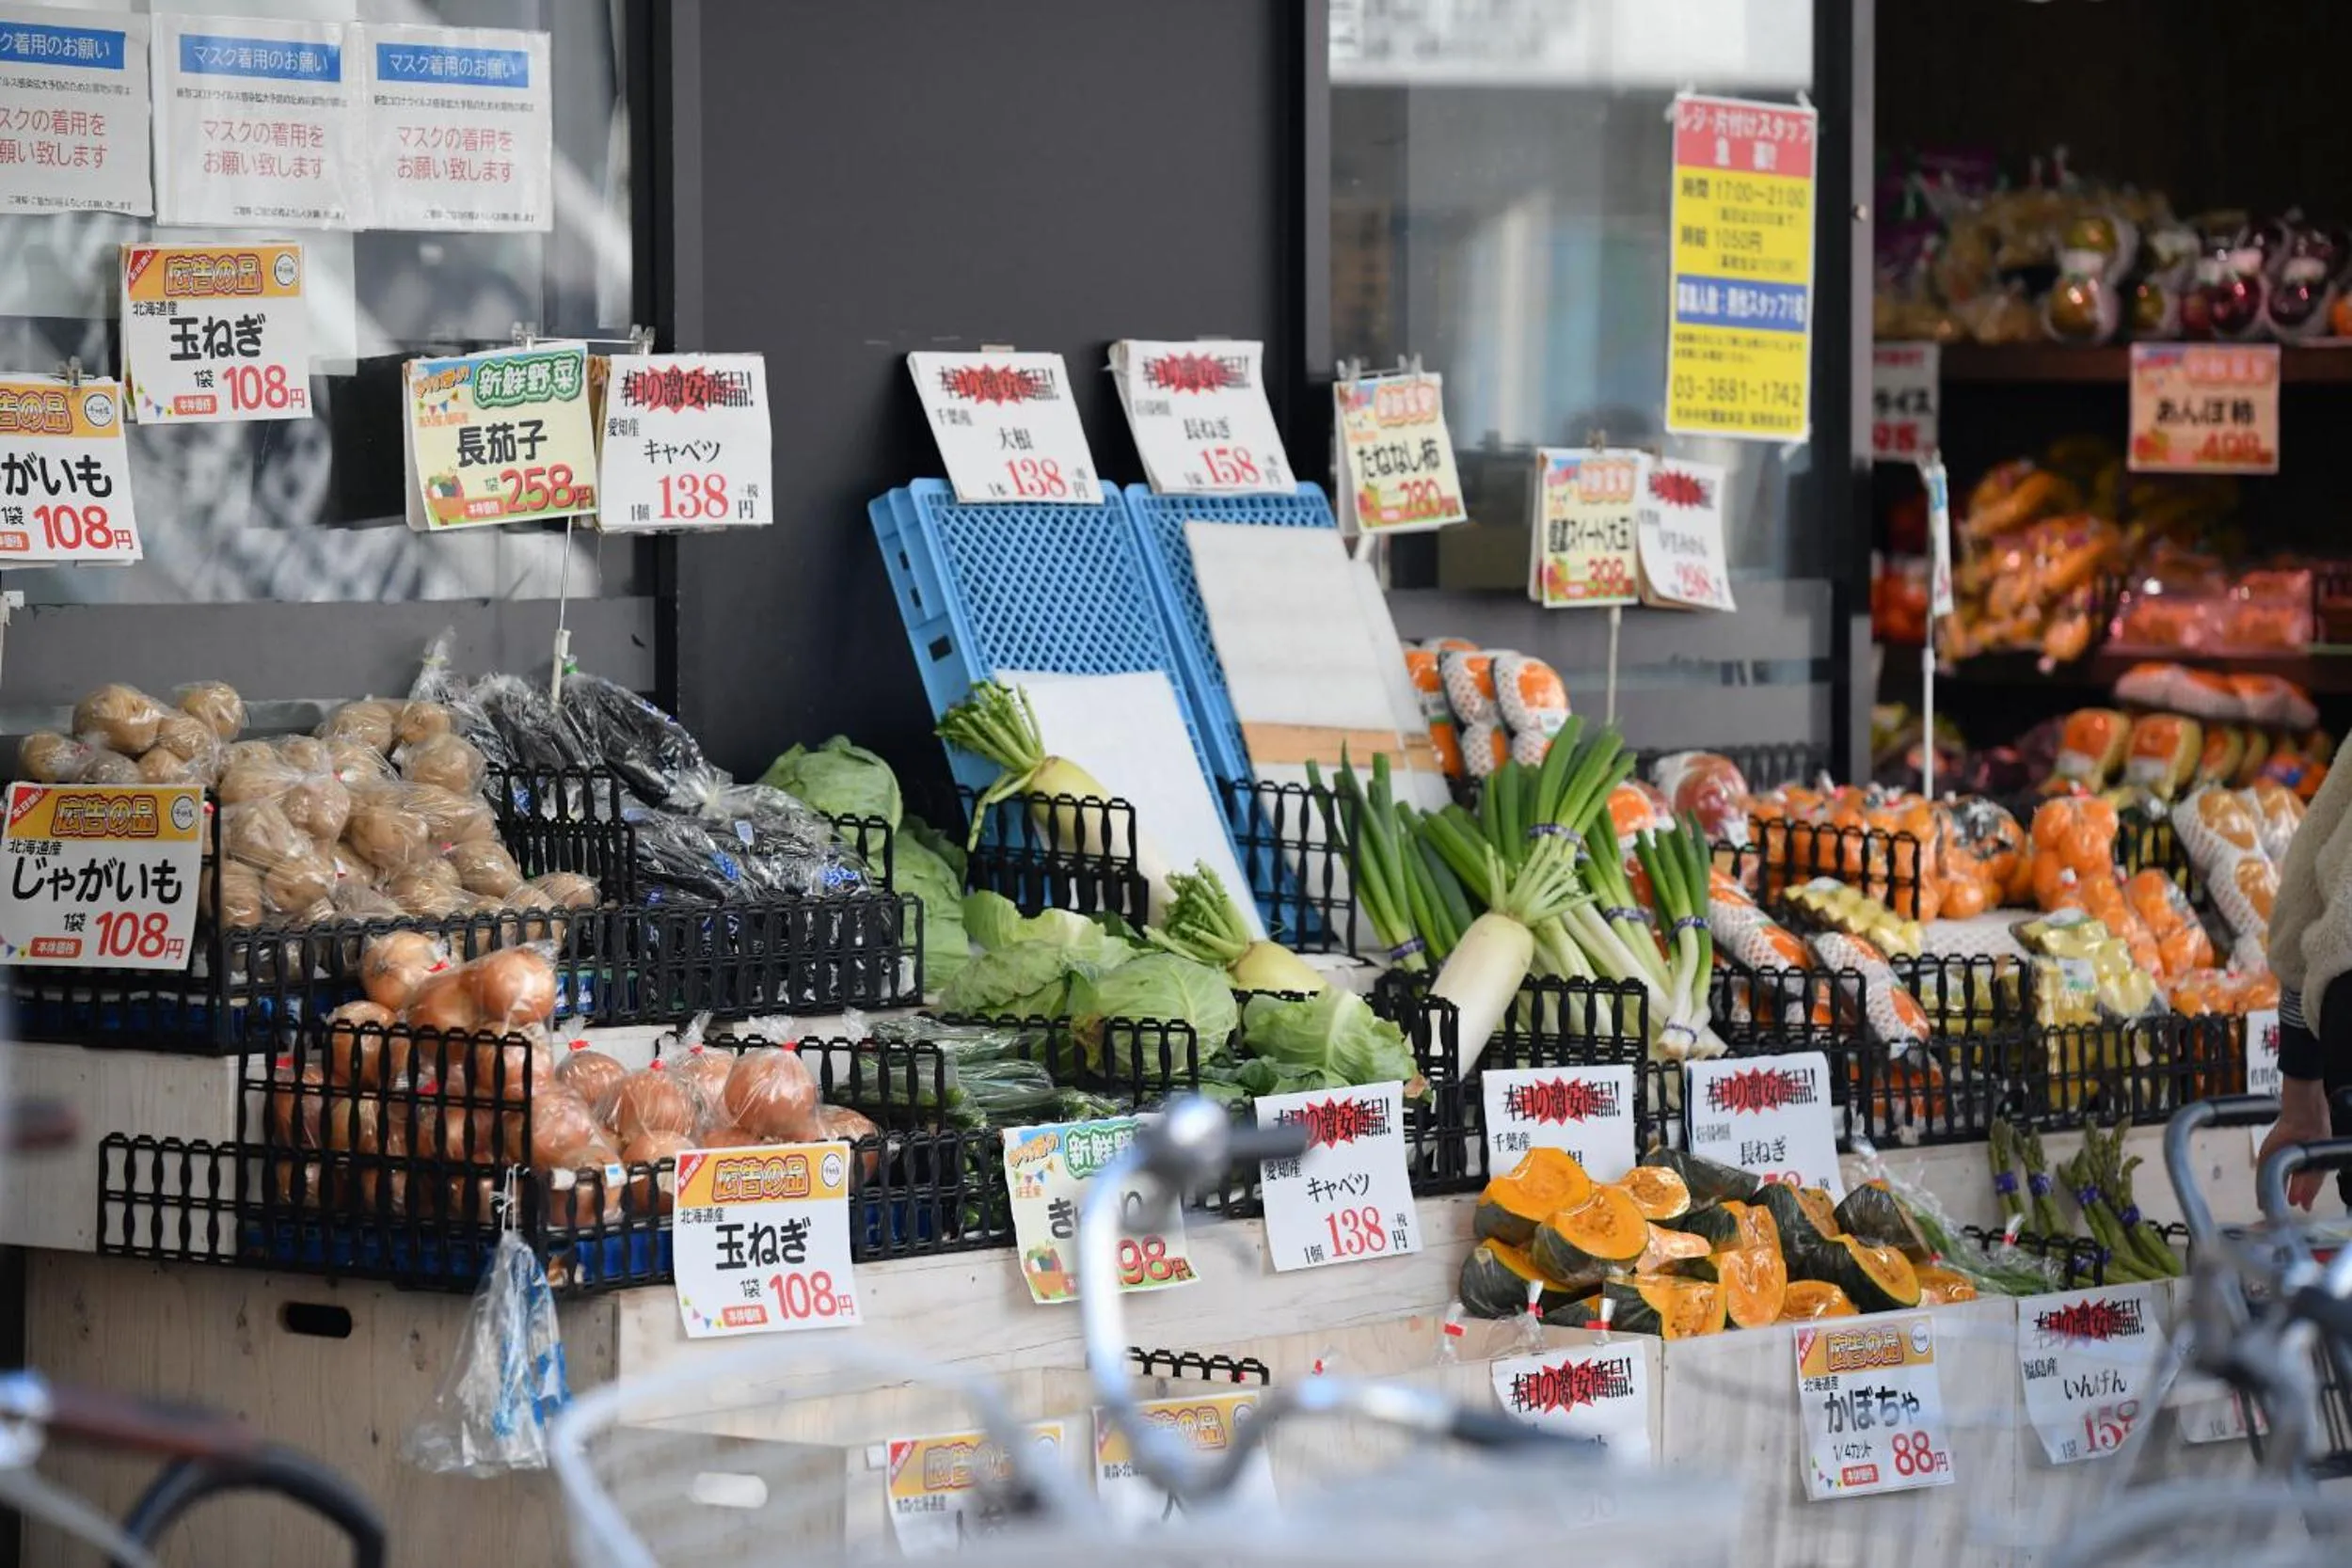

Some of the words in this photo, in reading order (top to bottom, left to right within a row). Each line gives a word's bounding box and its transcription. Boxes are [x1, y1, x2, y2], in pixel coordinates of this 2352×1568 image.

[0, 31, 110, 59] ク着用のお願い
[193, 46, 328, 73] マスク着用のお願い
[389, 54, 516, 80] マスク着用のお願い
[0, 107, 105, 136] スクの着用を
[202, 120, 325, 148] マスクの着用を
[396, 126, 514, 152] マスクの着用を
[202, 150, 326, 179] お願い致します
[396, 155, 516, 183] お願い致します
[169, 313, 266, 361] 玉ねぎ
[222, 364, 289, 410] 108
[291, 388, 306, 408] 円
[476, 356, 578, 401] 新鮮野菜
[456, 420, 548, 467] 長茄子
[644, 438, 722, 466] キャベツ
[997, 426, 1034, 450] 大根
[1, 451, 113, 499] がいも
[1006, 458, 1067, 499] 138
[1200, 446, 1262, 485] 158
[500, 464, 576, 514] 258
[658, 472, 729, 519] 138
[739, 500, 755, 520] 円
[34, 504, 114, 550] 108
[114, 529, 134, 550] 円
[51, 793, 159, 837] 広告の品
[8, 839, 62, 856] 北海道産
[12, 857, 183, 904] じゃがいも
[63, 912, 87, 932] 1袋
[95, 911, 169, 958] 108
[165, 938, 185, 959] 円
[1740, 1134, 1788, 1165] 長ねぎ
[712, 1153, 811, 1203] 広告の品
[1307, 1173, 1371, 1204] キャベツ
[680, 1207, 724, 1224] 北海道産
[1325, 1206, 1386, 1257] 138
[1391, 1228, 1408, 1250] 円
[715, 1216, 812, 1270] 玉ねぎ
[769, 1270, 837, 1320] 108
[838, 1294, 855, 1317] 円
[1509, 1356, 1635, 1413] 本日の激安商品!
[2063, 1370, 2127, 1401] いんげん
[1823, 1386, 1920, 1434] かぼちゃ
[1892, 1430, 1935, 1477] 88
[1935, 1451, 1949, 1474] 円
